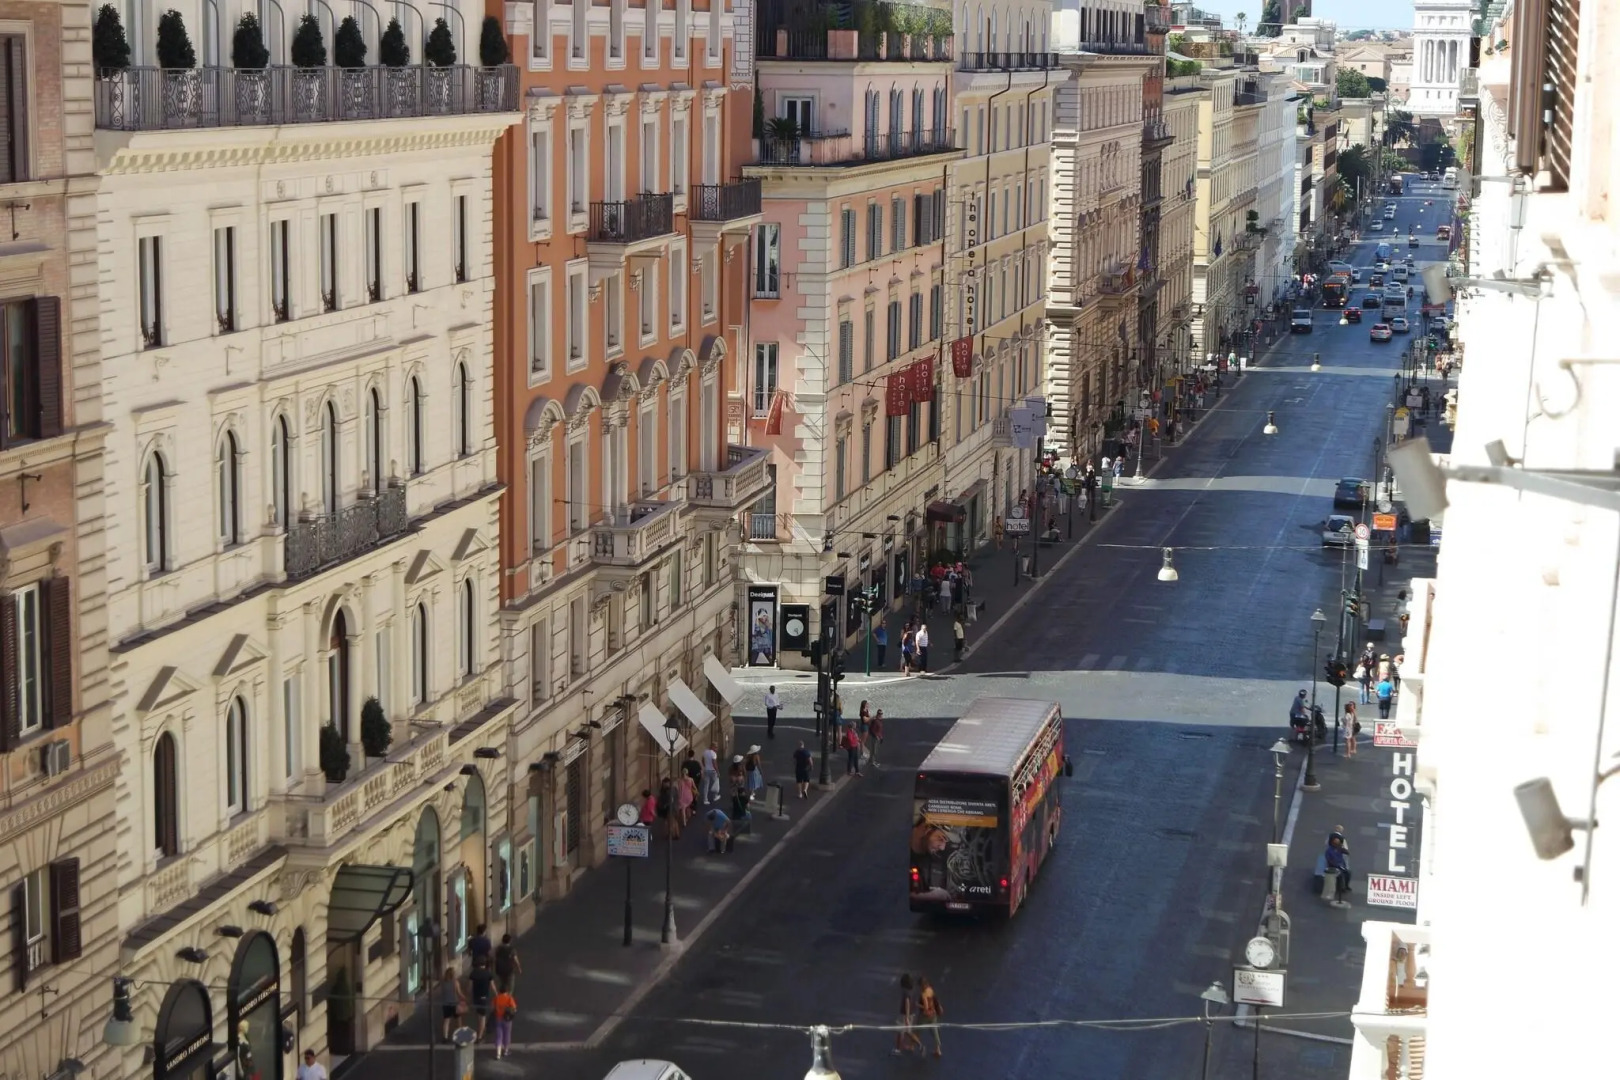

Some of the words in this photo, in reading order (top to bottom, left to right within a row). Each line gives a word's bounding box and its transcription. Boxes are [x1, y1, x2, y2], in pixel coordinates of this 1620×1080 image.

[968, 191, 977, 222] the
[967, 229, 976, 277] opera
[966, 284, 975, 336] hotel
[898, 376, 906, 414] hotel
[1007, 521, 1029, 530] hotel
[1388, 752, 1412, 872] HOTEL
[1370, 878, 1416, 894] MIAMI
